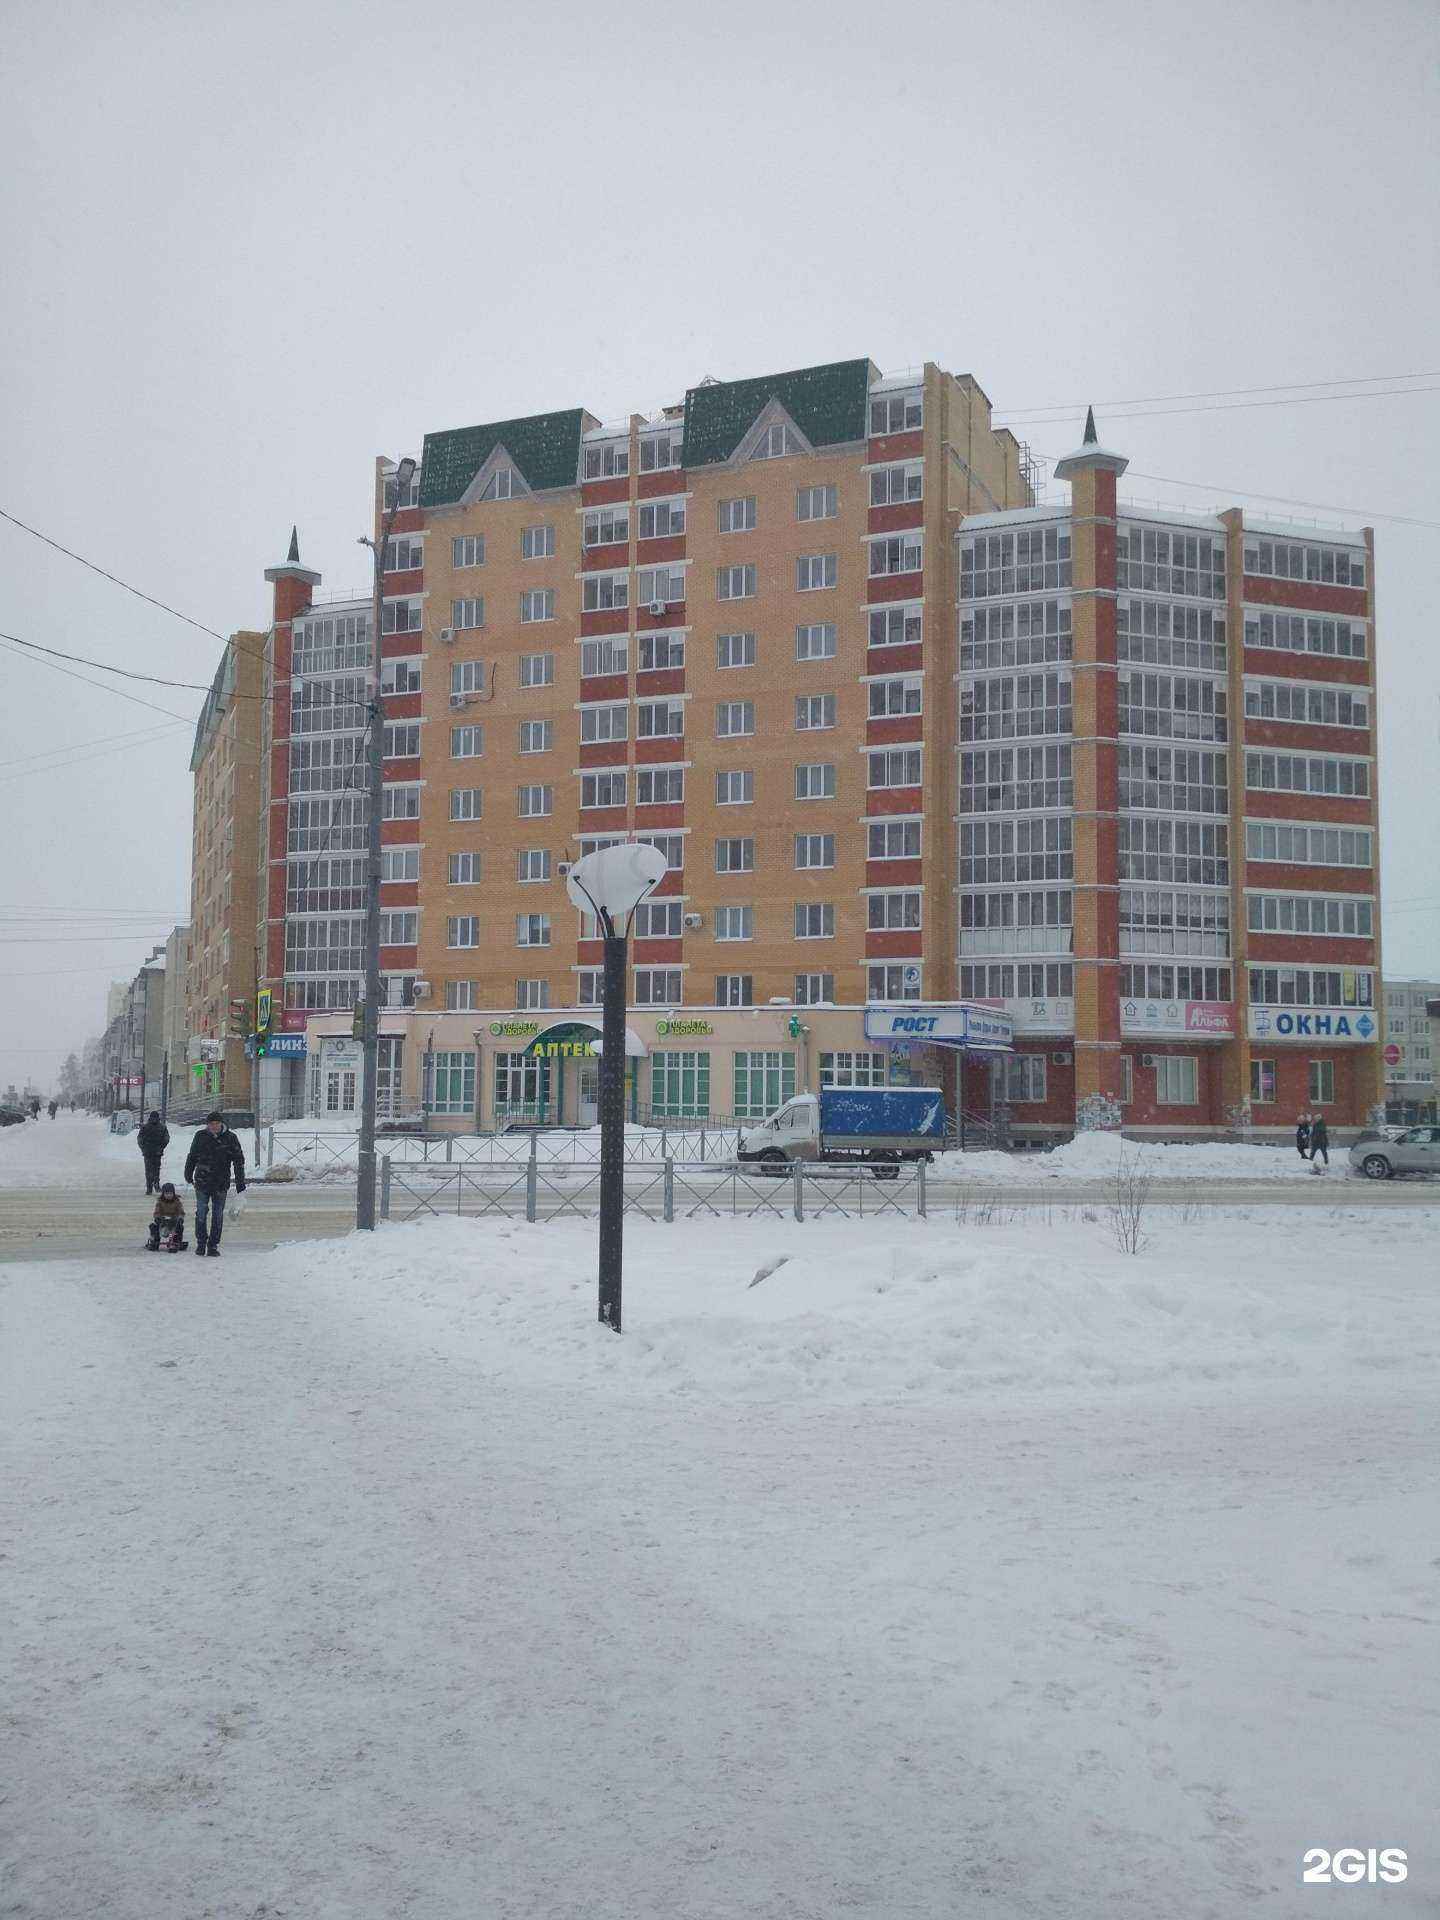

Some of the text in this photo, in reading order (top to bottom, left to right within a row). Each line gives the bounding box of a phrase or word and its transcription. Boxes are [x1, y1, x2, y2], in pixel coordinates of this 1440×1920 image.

[891, 1016, 939, 1032] РОСТ
[1276, 1013, 1352, 1036] ОКНА
[270, 1039, 309, 1051] ЛИНЗ
[533, 1042, 598, 1057] АПТЕК
